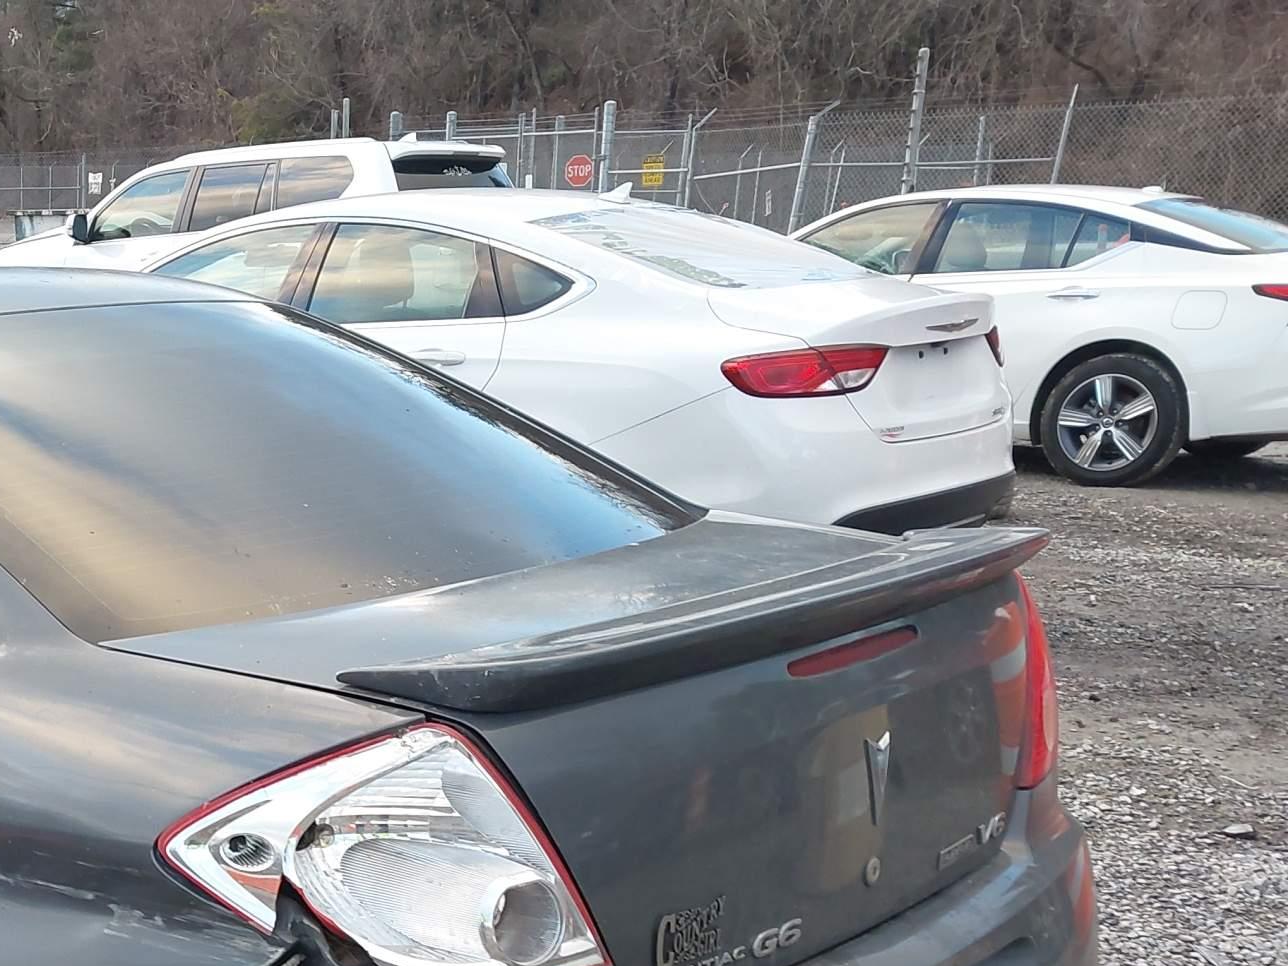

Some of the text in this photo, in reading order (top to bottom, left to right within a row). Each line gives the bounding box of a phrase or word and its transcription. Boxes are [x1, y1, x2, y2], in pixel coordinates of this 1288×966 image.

[567, 164, 592, 178] STOP
[977, 811, 1007, 844] V6
[752, 917, 803, 959] G6
